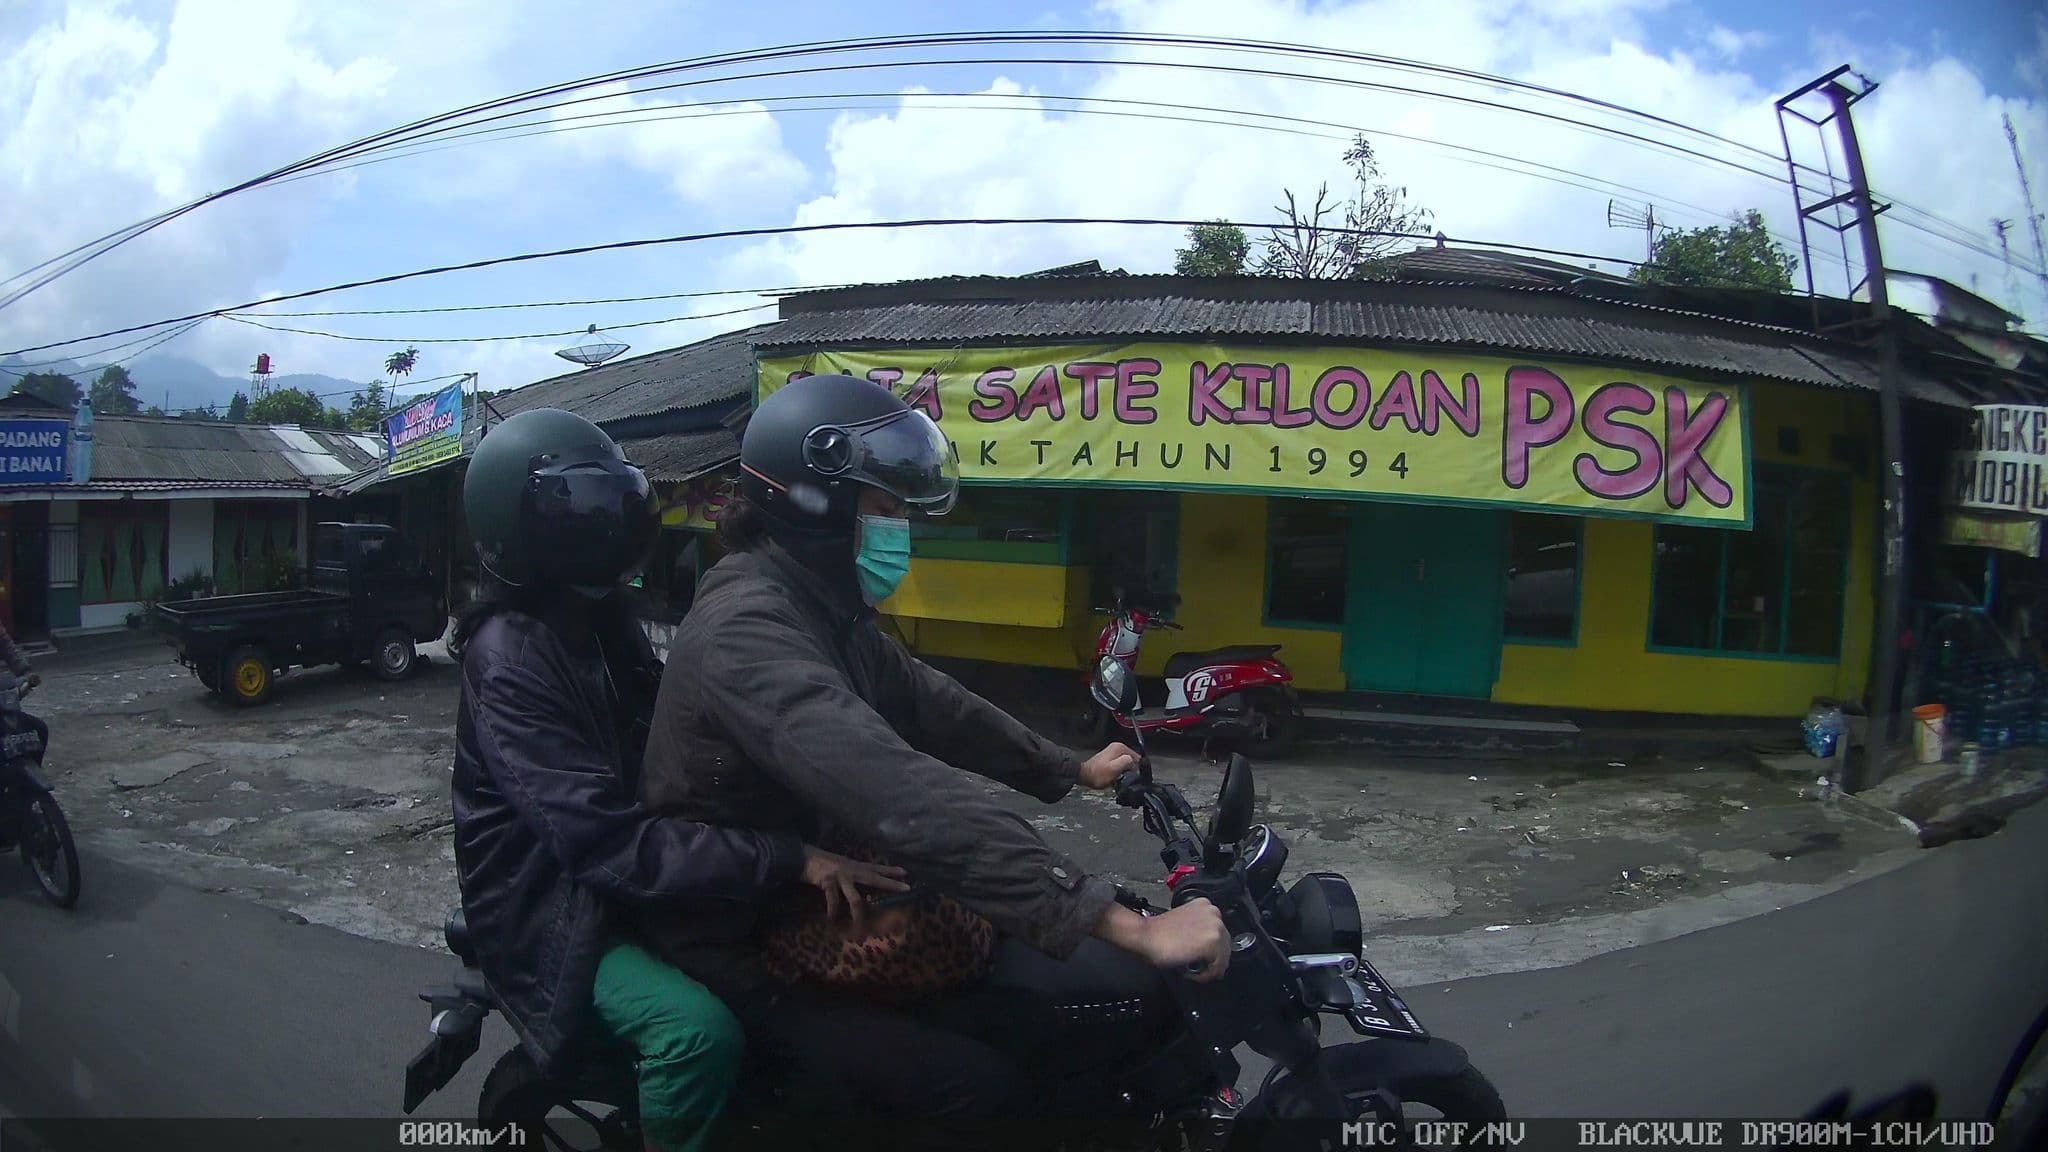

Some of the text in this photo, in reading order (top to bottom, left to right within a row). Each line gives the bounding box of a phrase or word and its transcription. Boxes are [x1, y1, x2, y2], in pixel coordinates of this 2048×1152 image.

[431, 410, 453, 432] KACA
[968, 357, 1162, 423] SATE
[1188, 360, 1480, 437] KILOAN
[1502, 365, 1733, 508] PSK
[0, 431, 61, 448] PADANG
[9, 456, 53, 473] BANA
[1030, 440, 1232, 472] TAHUN
[1269, 445, 1409, 480] 1994
[1956, 460, 2048, 509] MOBIL
